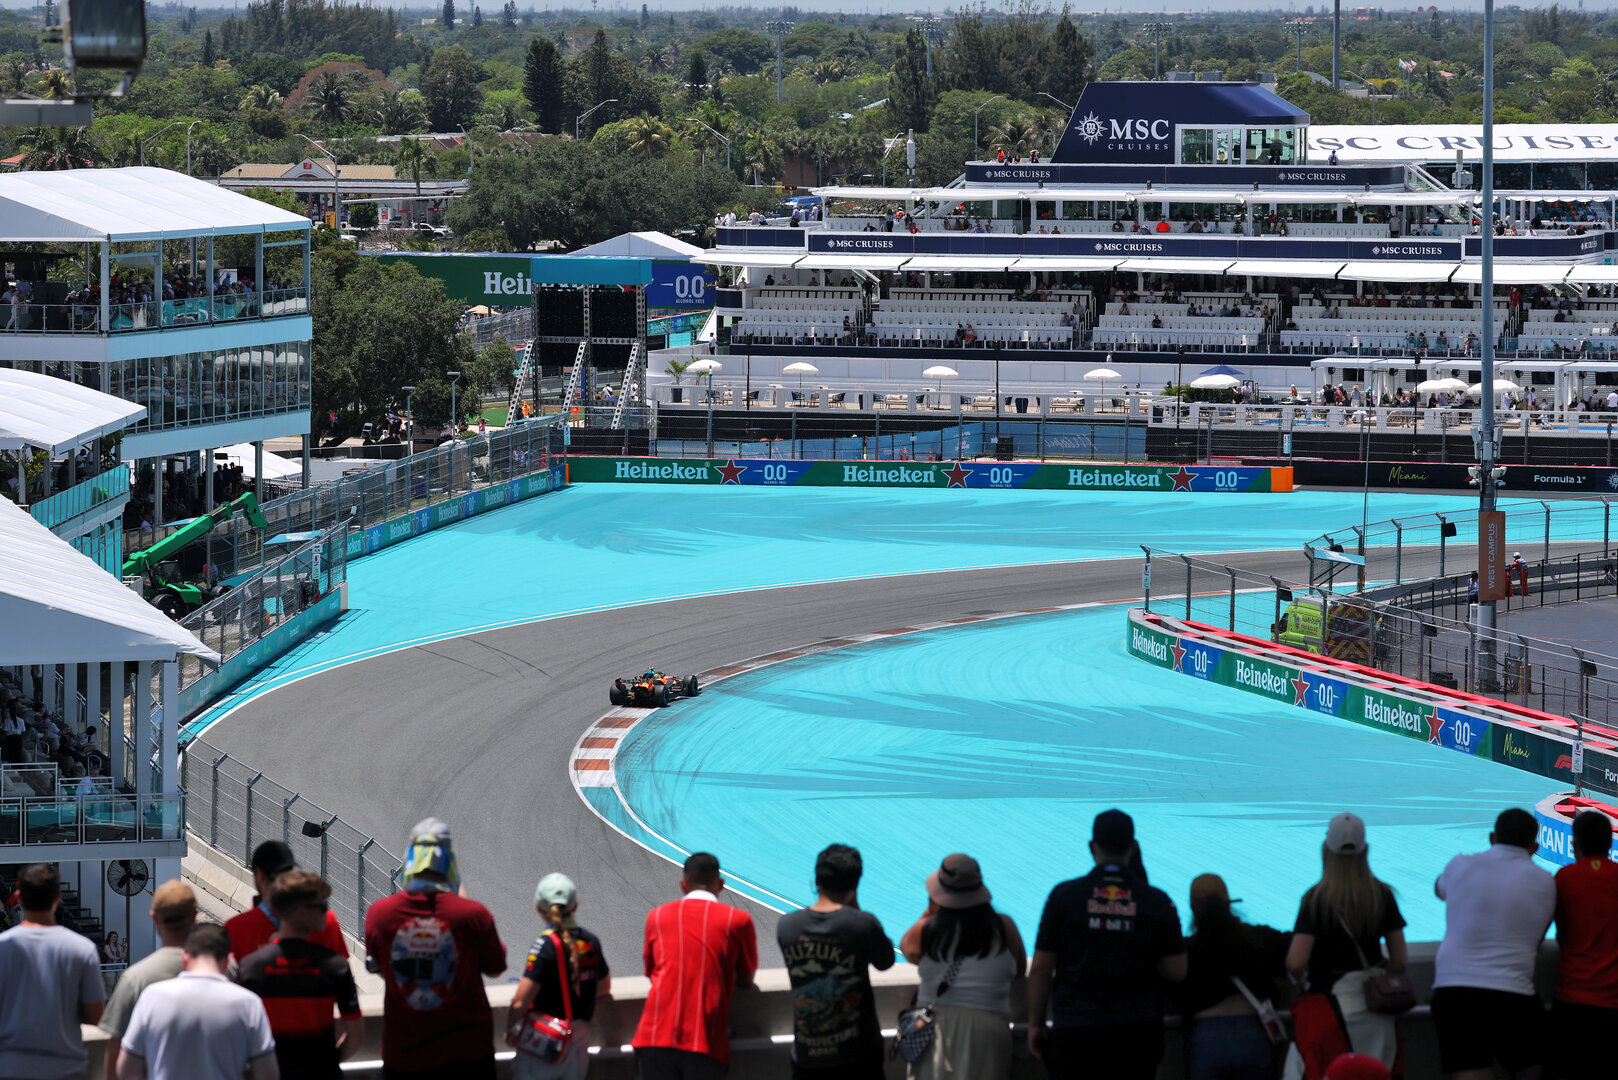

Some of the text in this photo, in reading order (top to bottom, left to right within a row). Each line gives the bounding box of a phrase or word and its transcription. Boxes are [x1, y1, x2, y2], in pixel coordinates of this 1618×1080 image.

[1109, 119, 1169, 140] MSC
[1108, 143, 1169, 151] CRUISES
[1308, 135, 1618, 151] SC CRUISE
[993, 170, 1051, 178] MSC CRUISES
[1287, 172, 1346, 181] MSC CRUISES
[836, 240, 894, 249] MSC CRUISES
[1103, 243, 1163, 252] MSC CRUISES
[1381, 246, 1442, 255] MSC CRUISES
[675, 275, 705, 298] 0.0
[615, 461, 709, 480] Heineken
[763, 464, 787, 481] 0.0
[843, 465, 936, 483] Heineken
[990, 467, 1012, 484] 0.0
[1068, 469, 1161, 487] Heineken
[1215, 471, 1238, 488] 0.0
[1388, 465, 1429, 484] Miami
[1533, 474, 1575, 484] Formula
[1487, 522, 1496, 589] WEST CAMPUS
[1132, 627, 1167, 662] Heineken
[1194, 649, 1207, 673] 0.0
[1236, 659, 1288, 696] Heineken
[1318, 683, 1333, 708] 0.0
[1364, 694, 1422, 733] Heineken
[1454, 719, 1471, 746] 0.0
[1503, 732, 1530, 761] Miami
[1536, 823, 1565, 856] ICAN
[784, 941, 857, 969] SUZUKA
